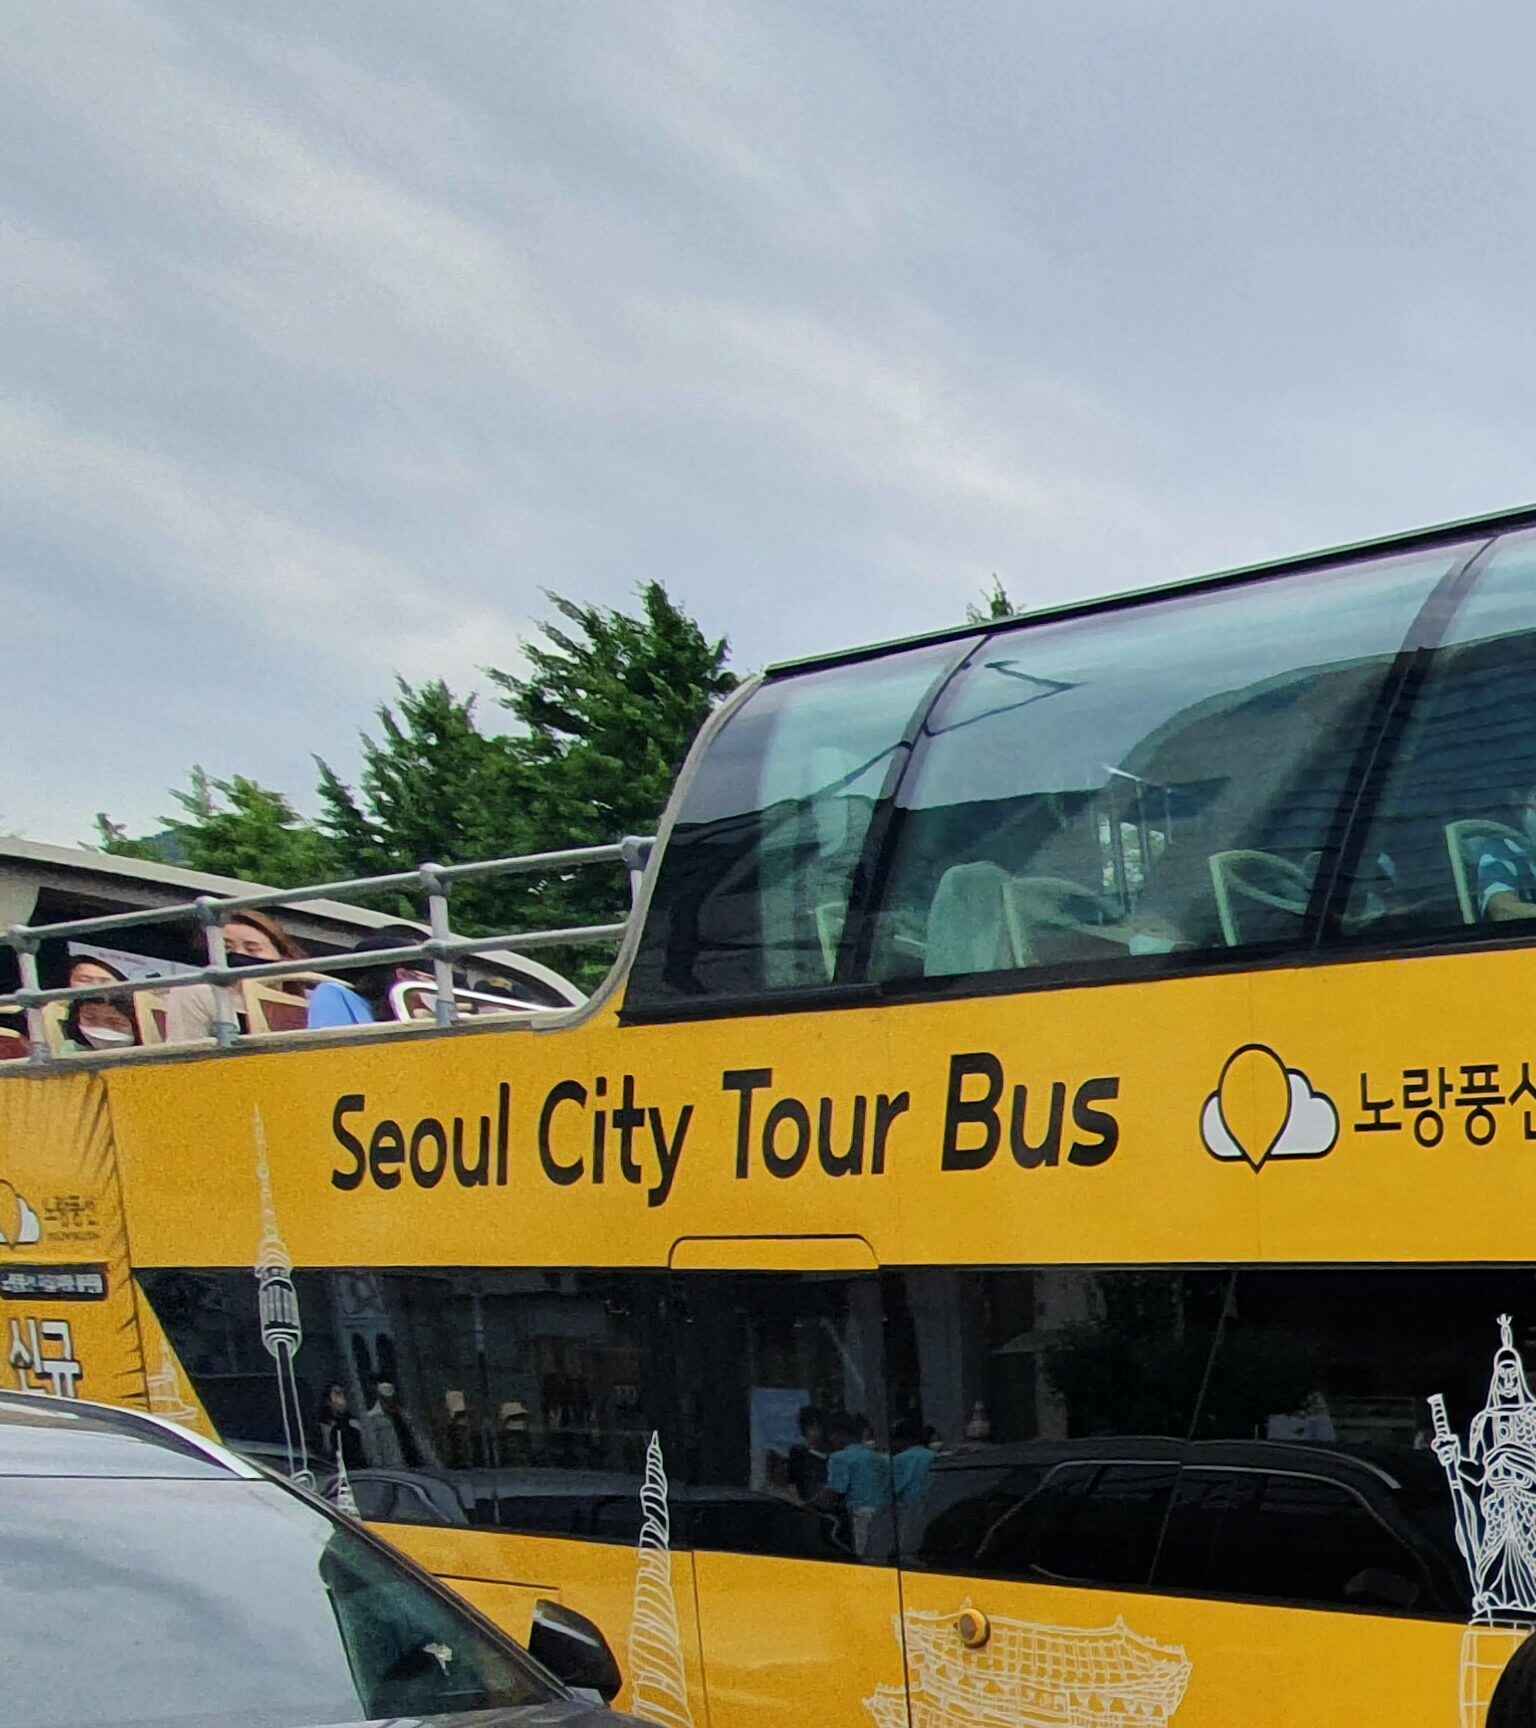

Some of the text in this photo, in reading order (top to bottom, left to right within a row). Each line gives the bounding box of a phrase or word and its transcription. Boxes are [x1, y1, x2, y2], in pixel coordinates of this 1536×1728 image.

[331, 1052, 1121, 1207] Seoul City Tour Bus
[9, 1317, 82, 1398] 신규
